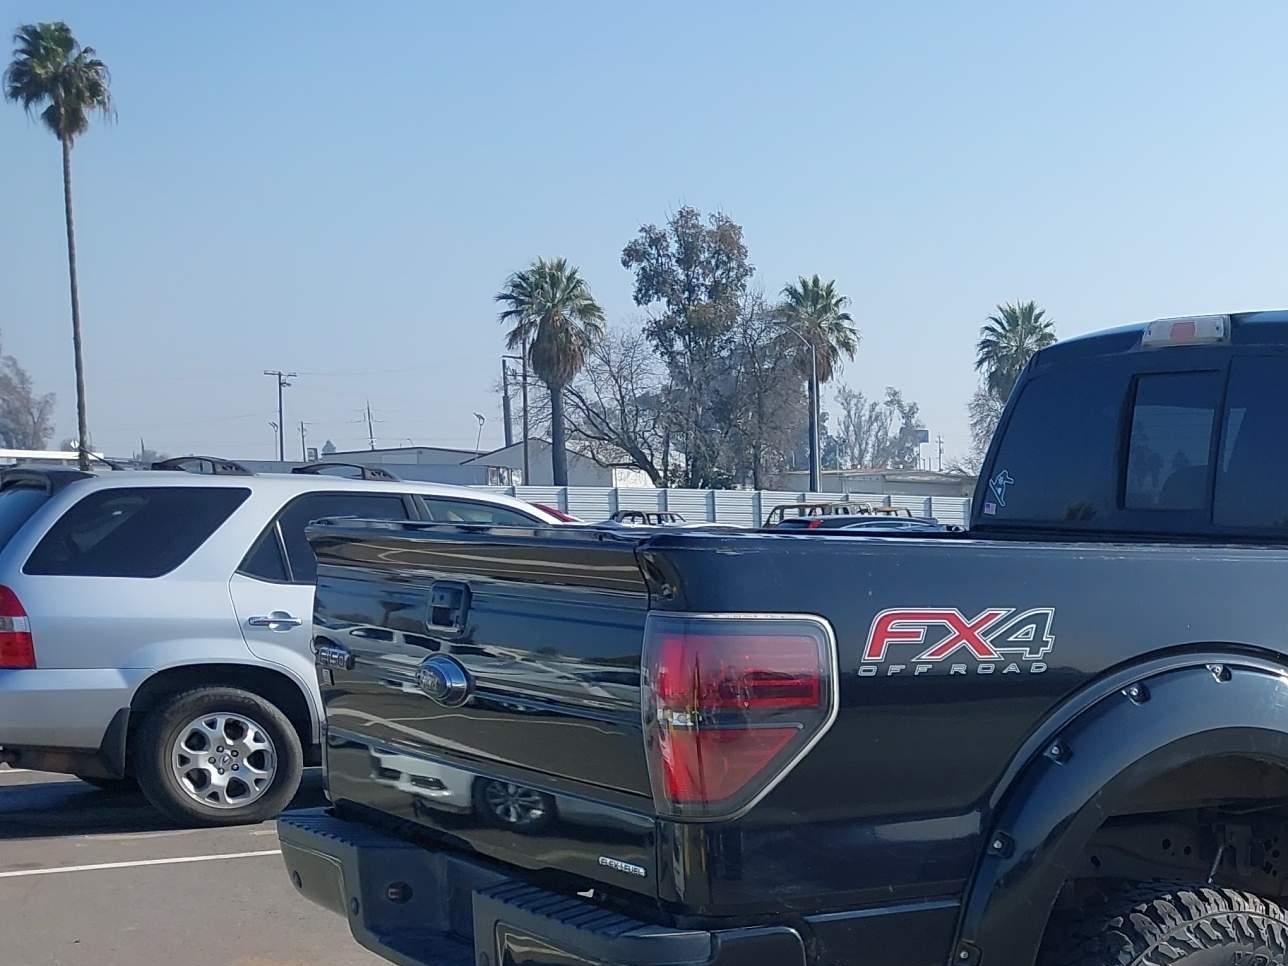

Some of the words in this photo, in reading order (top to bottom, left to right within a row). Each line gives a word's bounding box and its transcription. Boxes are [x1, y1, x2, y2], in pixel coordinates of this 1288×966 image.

[861, 607, 1055, 662] FX4
[857, 664, 933, 677] OFF
[950, 662, 1048, 675] ROAD
